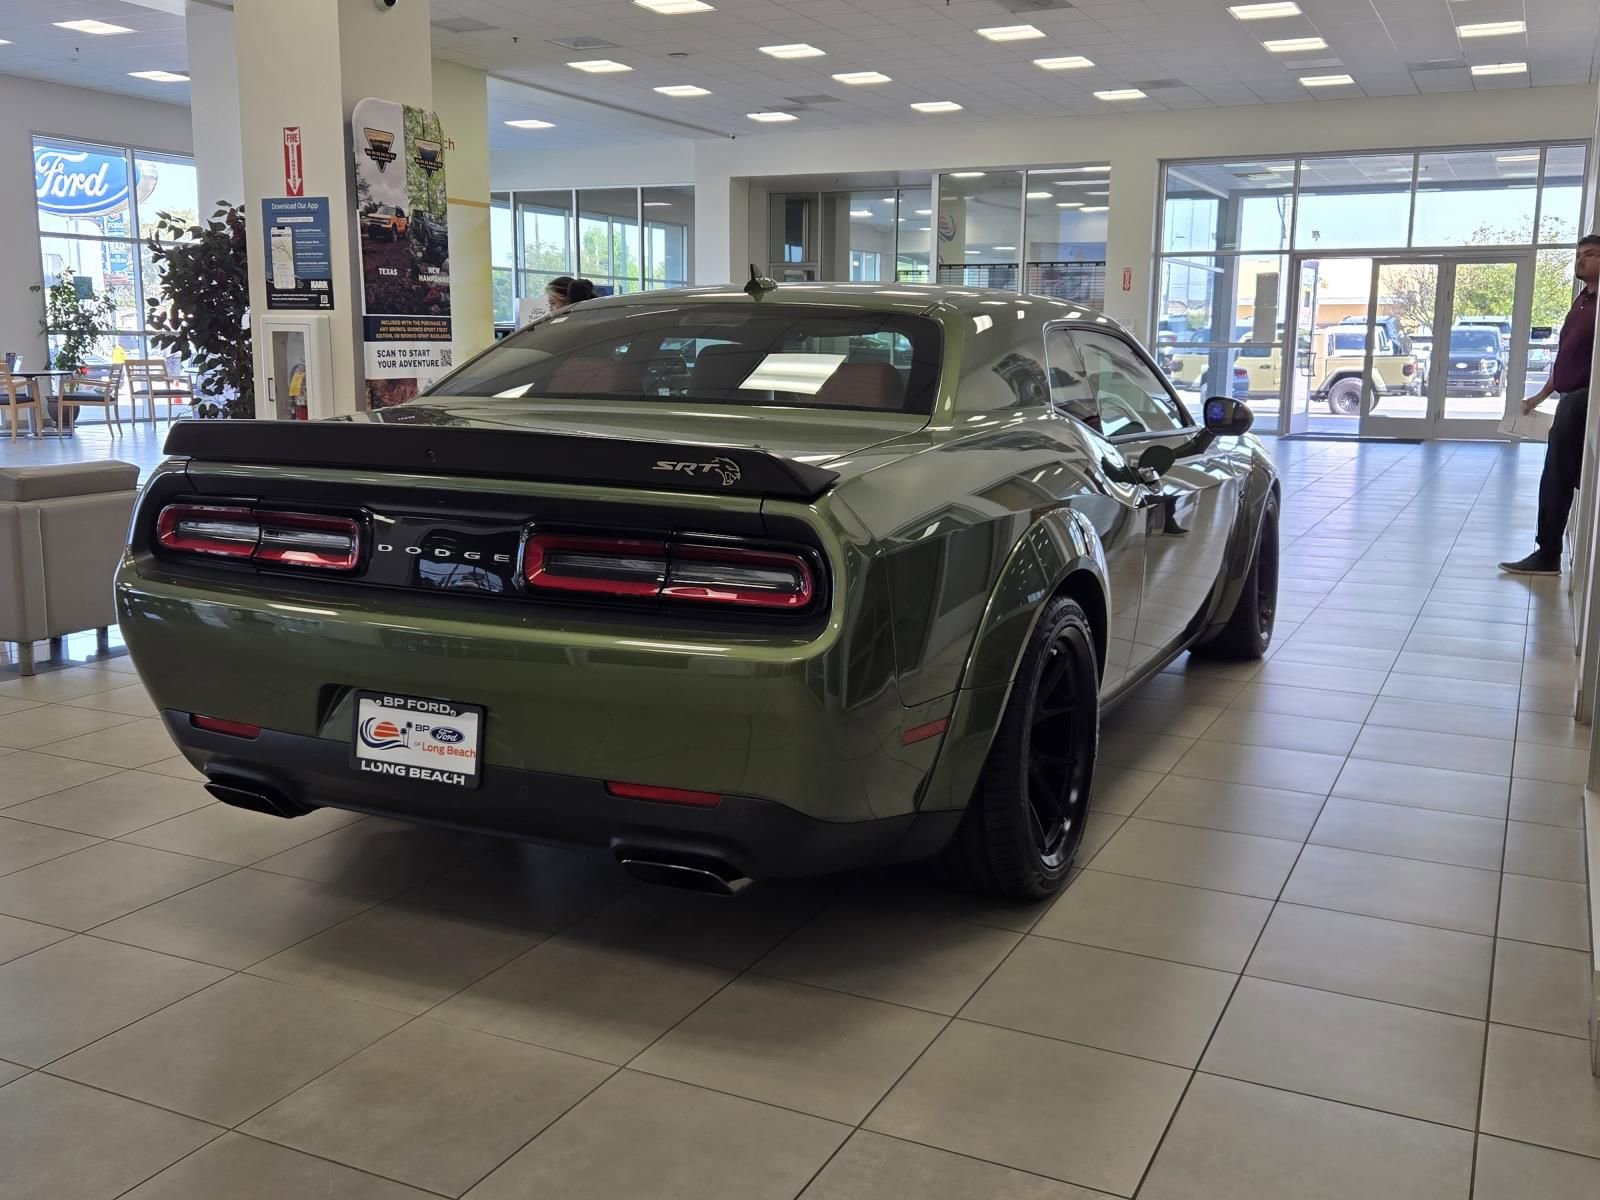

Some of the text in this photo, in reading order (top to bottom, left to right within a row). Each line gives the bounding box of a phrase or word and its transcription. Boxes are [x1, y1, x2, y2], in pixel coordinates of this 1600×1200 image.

[286, 133, 299, 143] FIRE
[36, 151, 109, 198] Ford
[271, 202, 296, 210] Download
[307, 201, 319, 210] App
[378, 267, 398, 276] TEXAS
[377, 349, 430, 358] SCAN TO START
[378, 360, 440, 368] YOUR ADVENTURE
[652, 461, 720, 476] SRT
[377, 543, 511, 563] DODGE
[383, 696, 450, 714] BP FORD
[415, 723, 458, 743] BP Ford
[422, 742, 445, 756] Long
[447, 746, 476, 758] Beach
[361, 760, 466, 786] LONG BEACH
